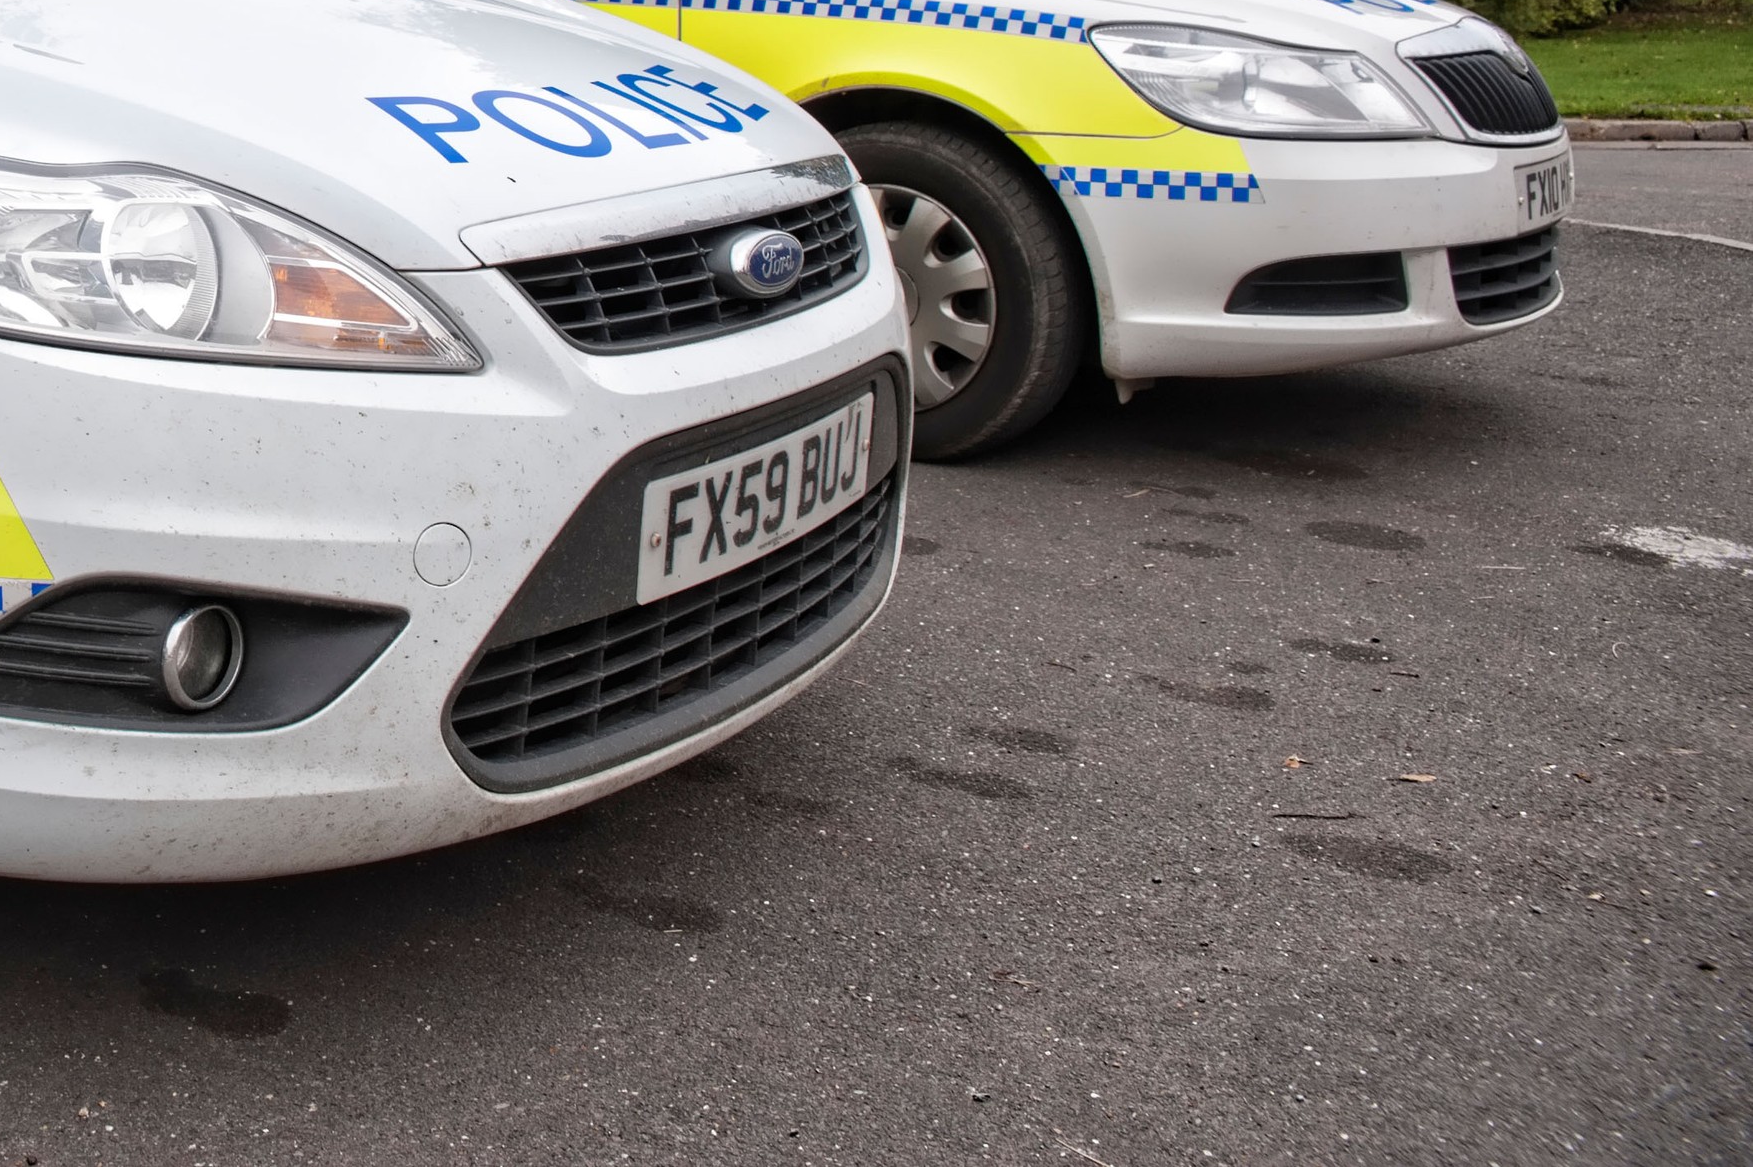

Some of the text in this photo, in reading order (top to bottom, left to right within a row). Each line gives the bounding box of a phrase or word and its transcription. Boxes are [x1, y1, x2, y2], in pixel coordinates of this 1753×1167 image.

[364, 64, 771, 164] POLICE
[1527, 166, 1560, 221] FX10
[762, 242, 795, 279] Ford
[664, 410, 861, 576] FX59 BUJ
